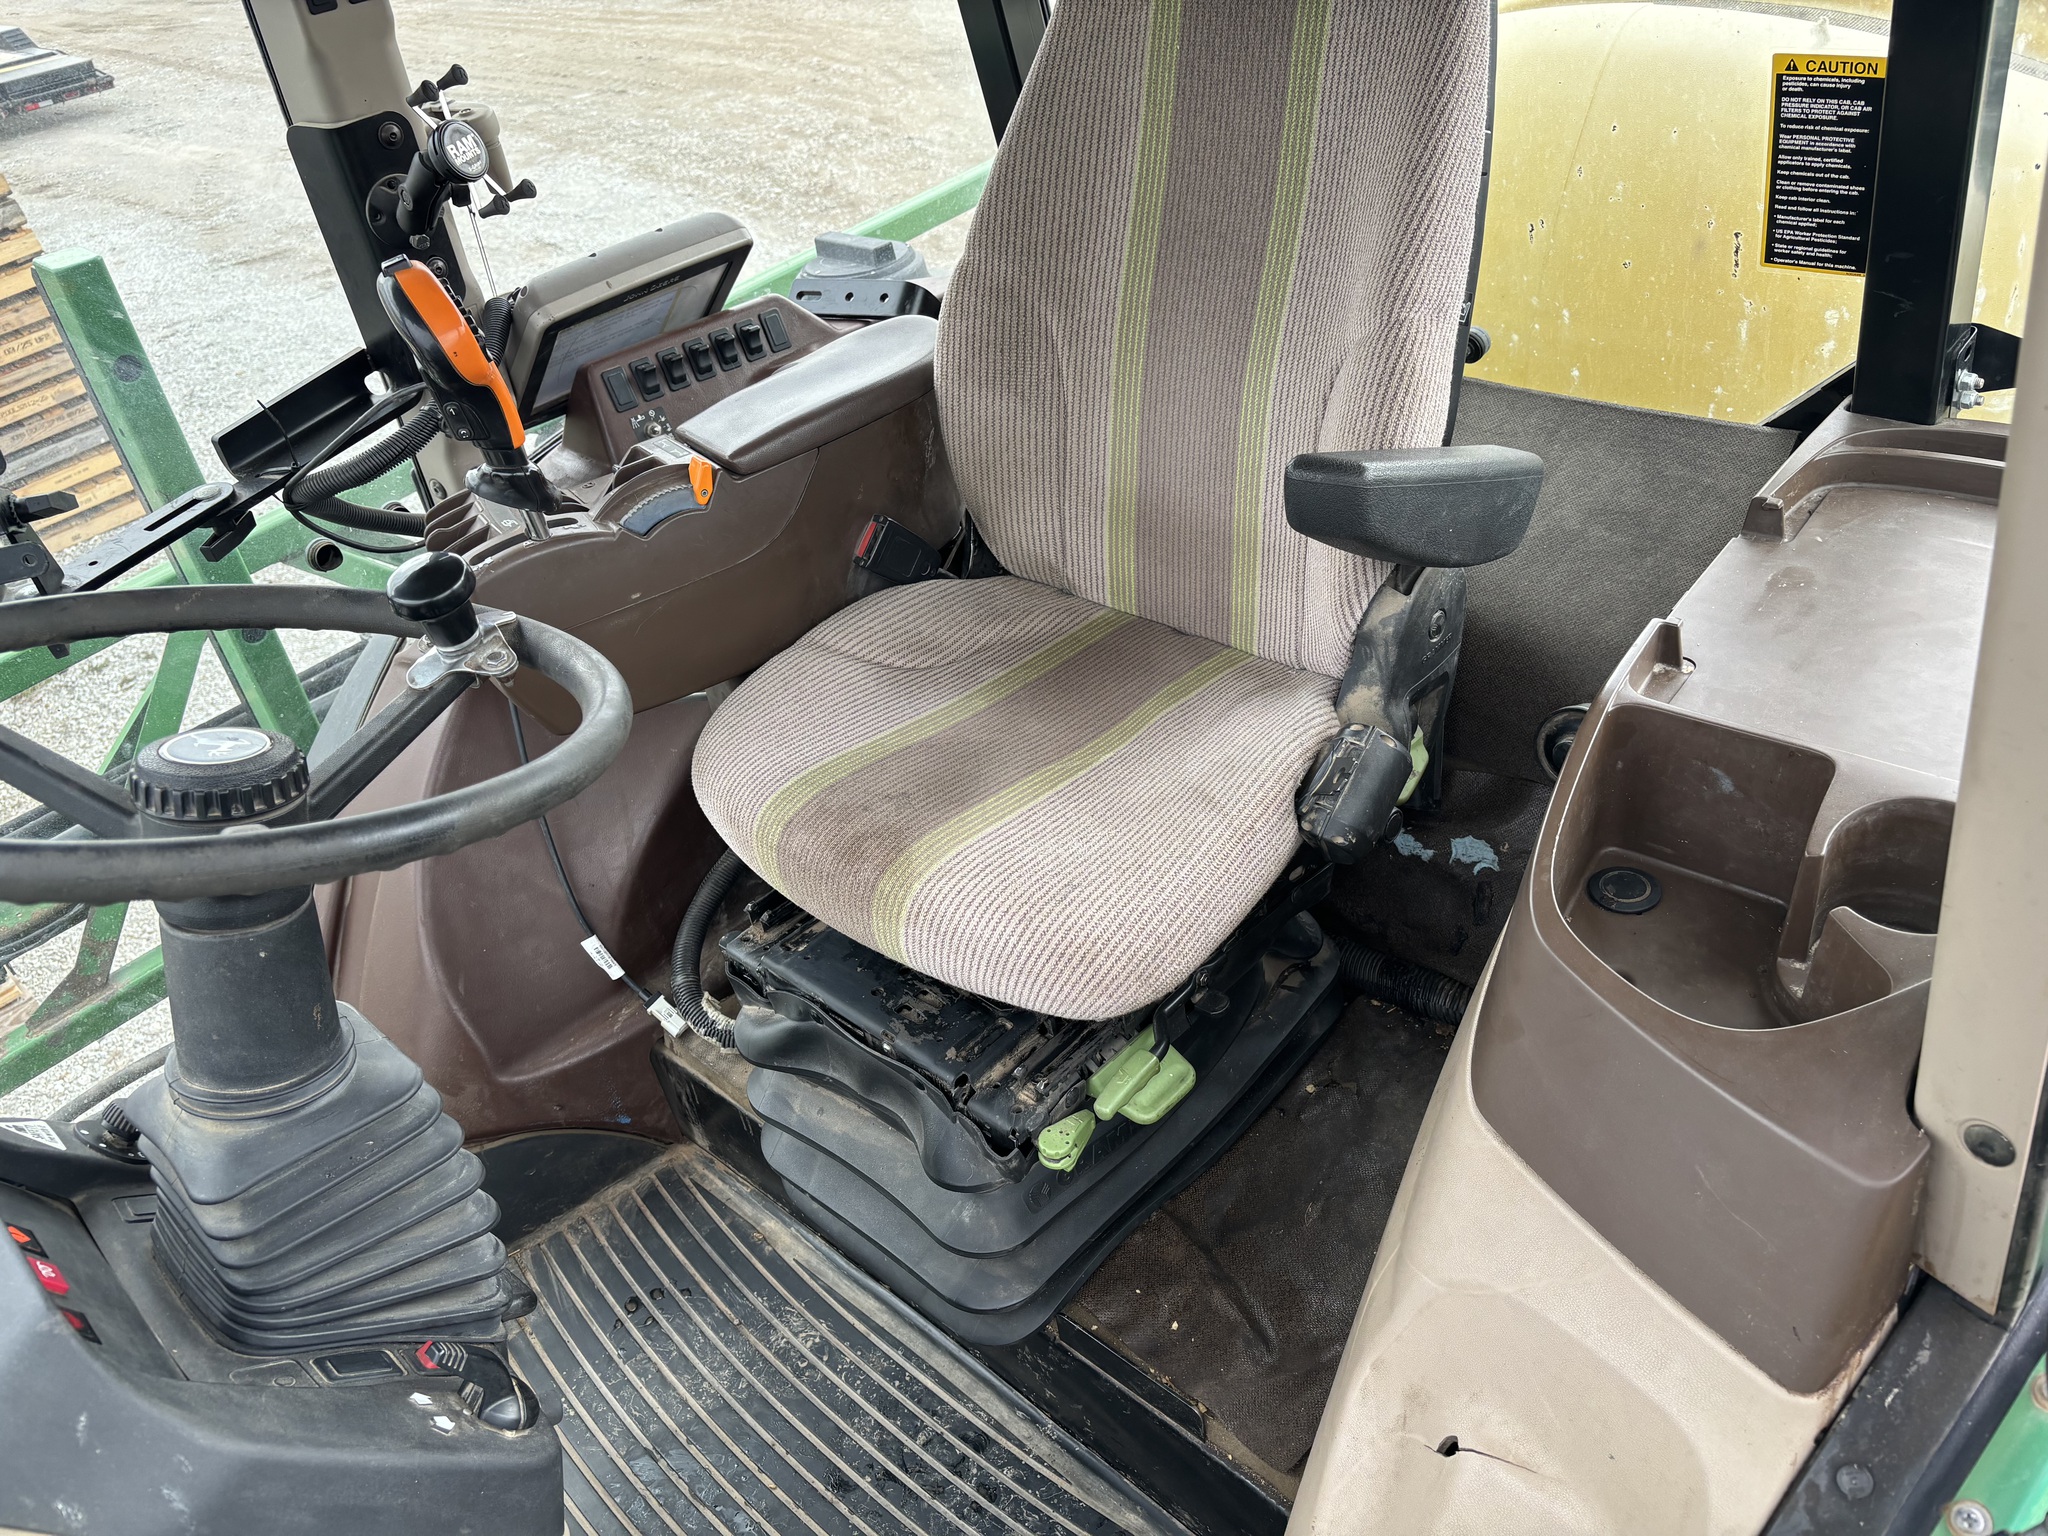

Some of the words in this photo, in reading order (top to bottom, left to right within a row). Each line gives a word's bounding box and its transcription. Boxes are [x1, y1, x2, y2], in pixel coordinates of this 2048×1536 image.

[1806, 60, 1878, 75] CAUTION
[446, 133, 478, 159] RAM
[455, 146, 481, 166] MOUNTS
